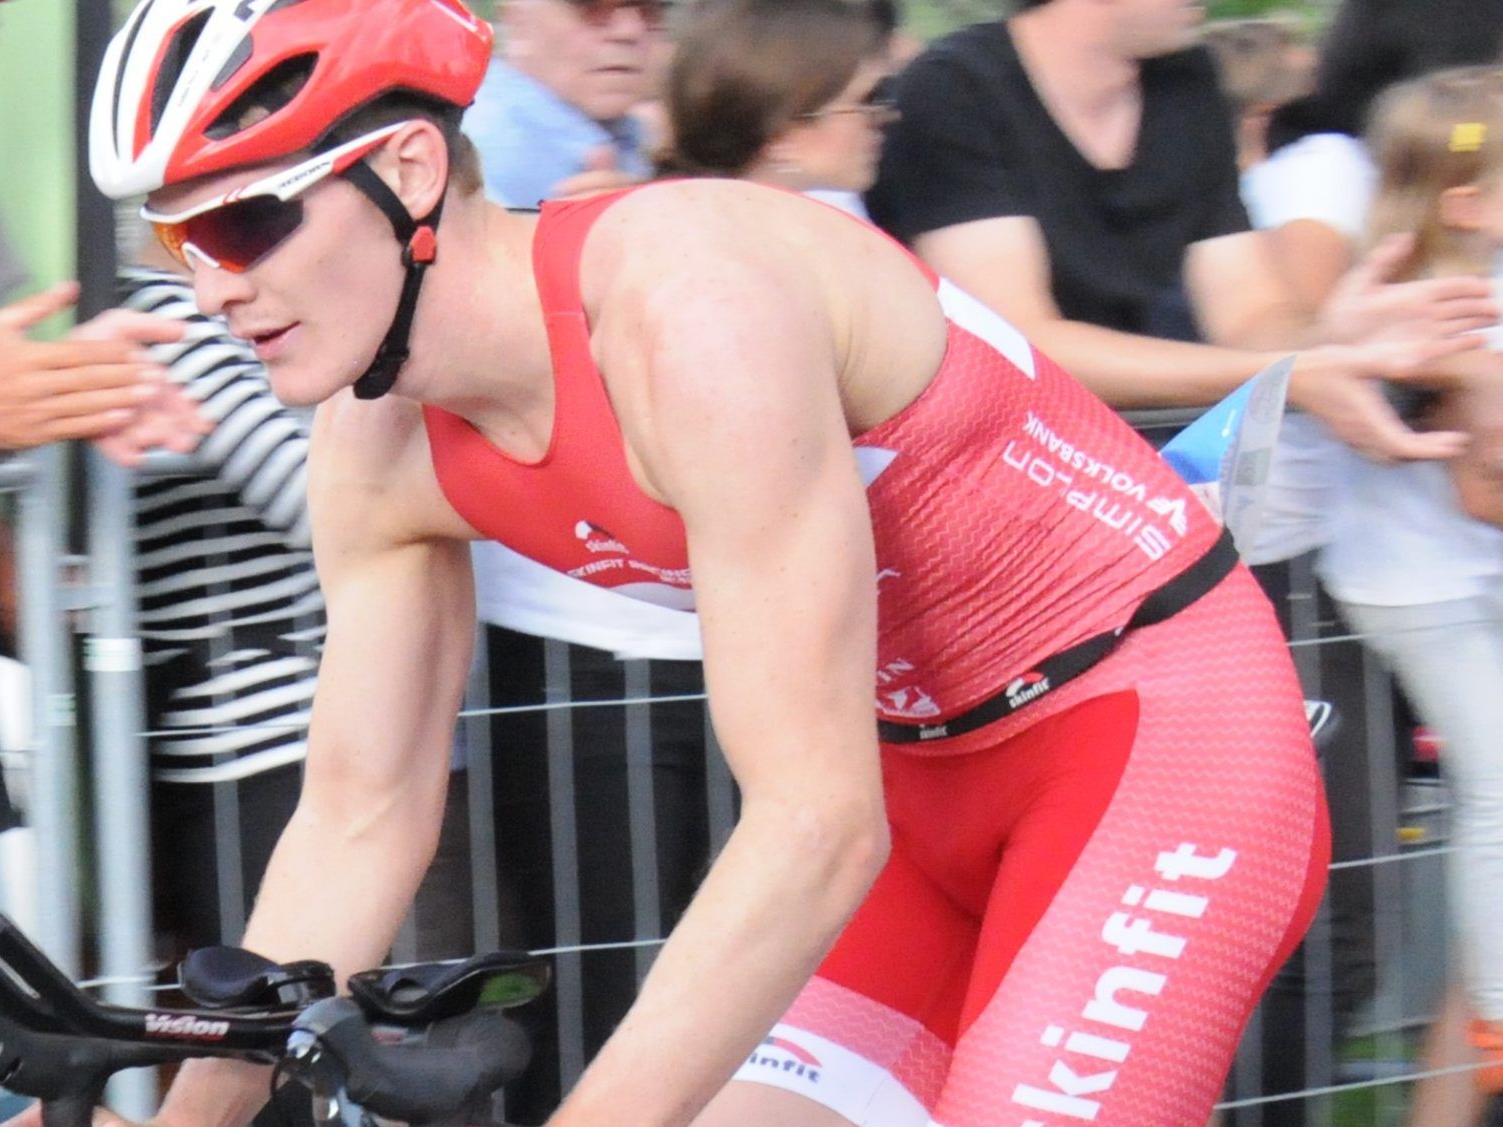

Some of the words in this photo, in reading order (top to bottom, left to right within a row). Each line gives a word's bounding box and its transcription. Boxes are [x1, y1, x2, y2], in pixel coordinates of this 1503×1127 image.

[1023, 410, 1146, 502] VOLKSBANK
[1001, 440, 1172, 561] SIMPLON
[1008, 678, 1050, 709] skinfit
[144, 1013, 231, 1036] Vision
